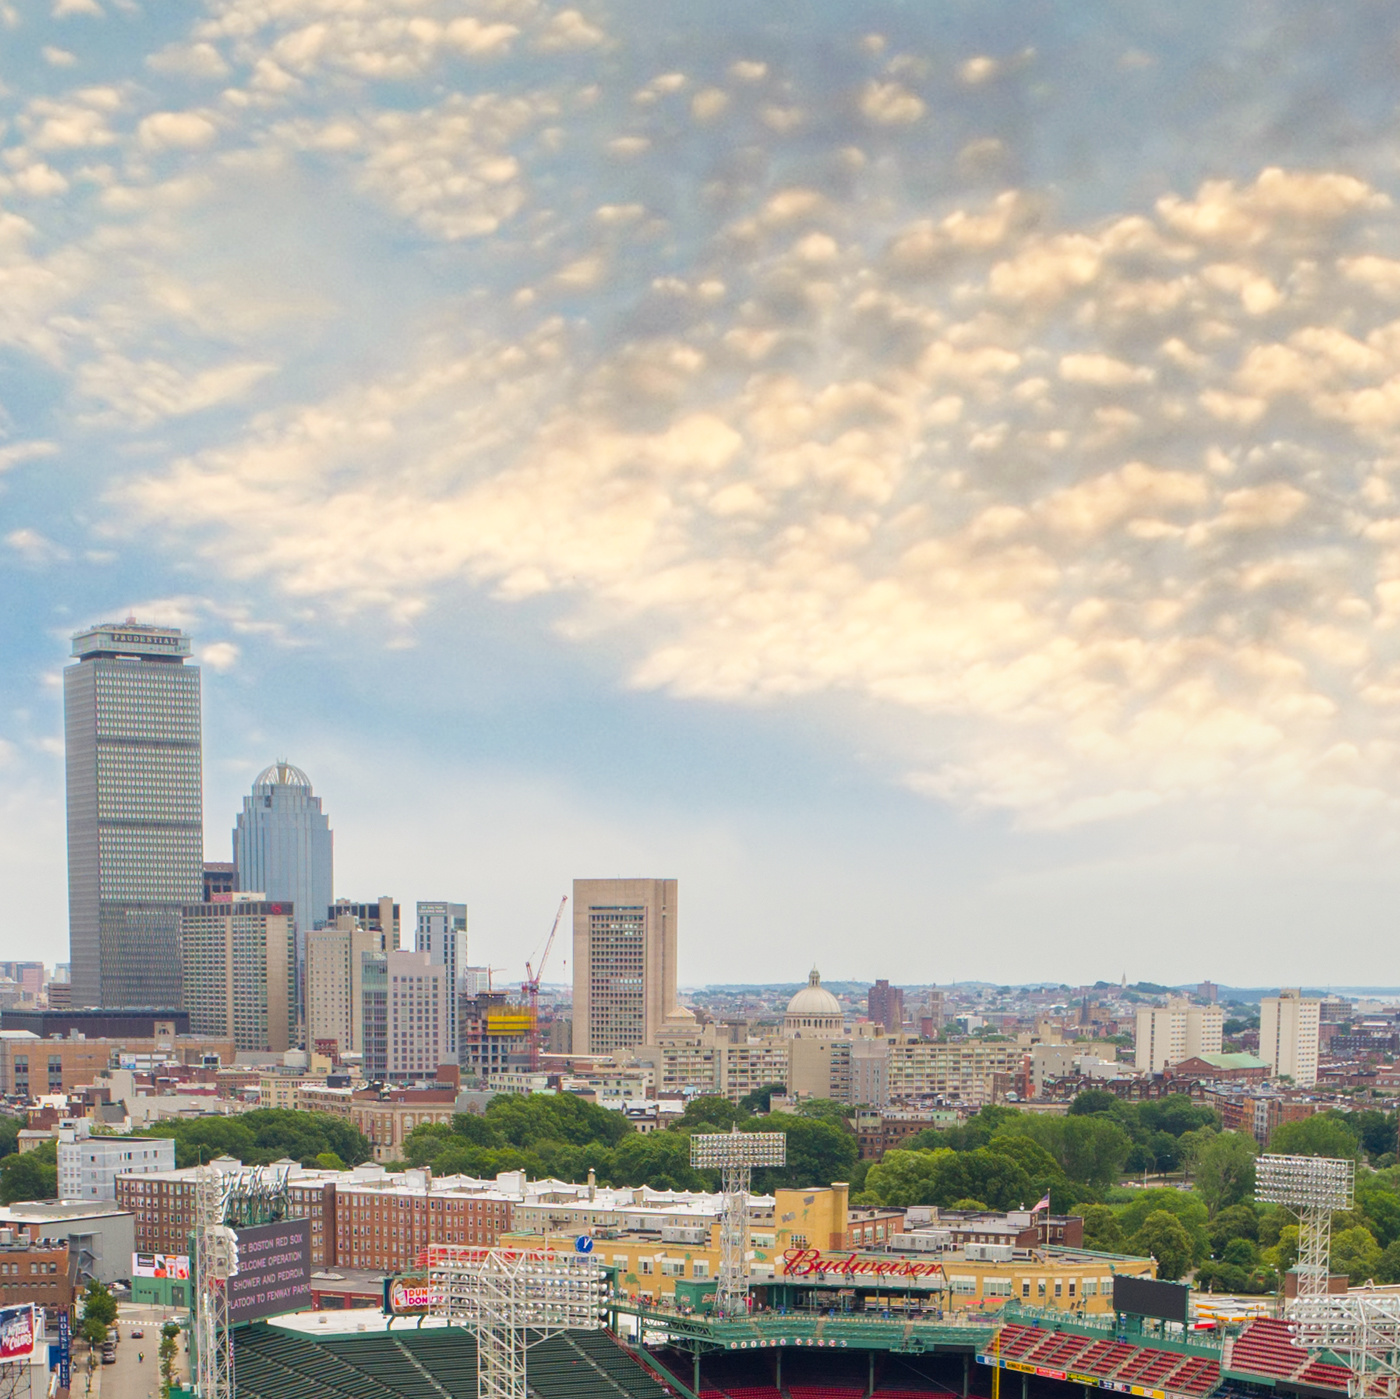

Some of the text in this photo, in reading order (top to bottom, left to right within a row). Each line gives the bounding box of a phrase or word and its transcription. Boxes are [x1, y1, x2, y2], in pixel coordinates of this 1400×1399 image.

[114, 634, 177, 645] PRUDENTIAL
[248, 1239, 274, 1253] BOSTON
[275, 1237, 288, 1248] RED
[290, 1234, 303, 1244] SOX
[268, 1251, 303, 1266] OPERATION
[783, 1248, 943, 1276] Budweiser
[233, 1268, 304, 1291] SHOWER AND PEDROIA
[227, 1295, 255, 1310] PLATOON
[257, 1293, 265, 1303] TO
[267, 1286, 291, 1300] FENWAY
[60, 1316, 68, 1350] HOUSE
